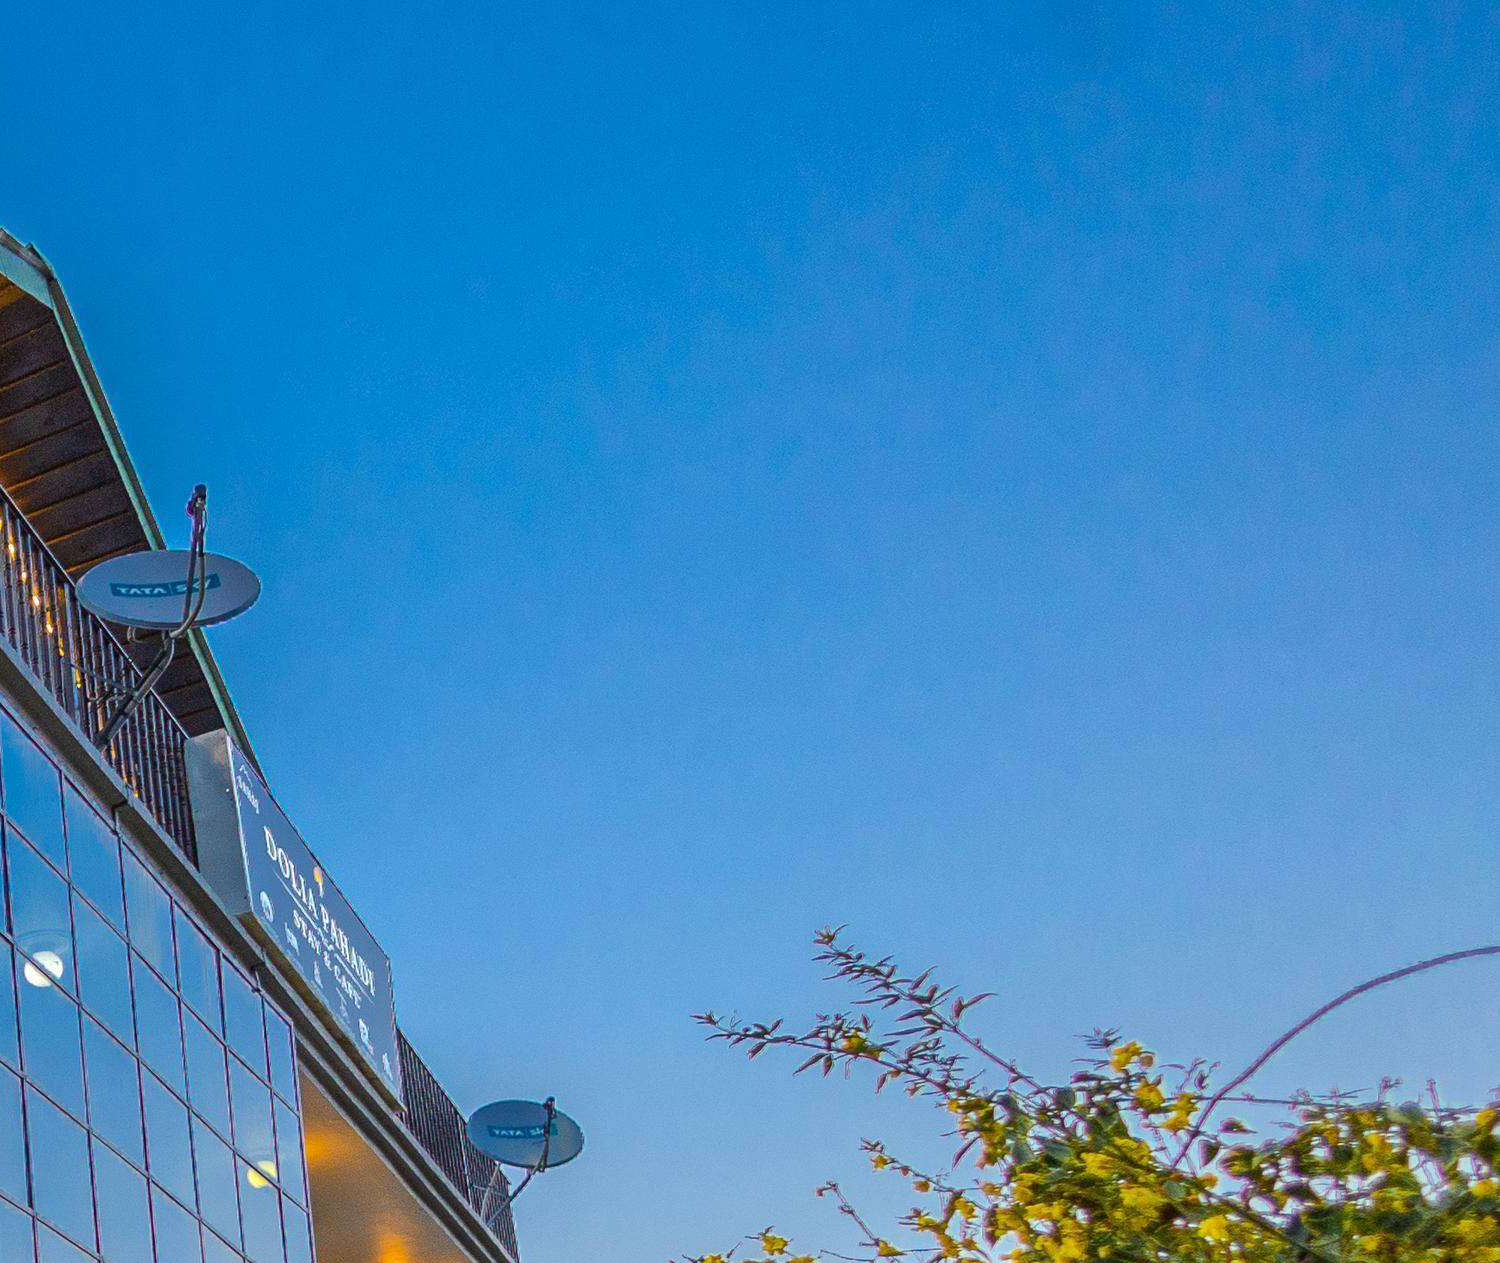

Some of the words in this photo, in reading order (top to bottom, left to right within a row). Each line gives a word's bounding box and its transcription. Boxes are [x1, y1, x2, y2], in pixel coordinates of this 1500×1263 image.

[116, 586, 167, 596] TATA
[264, 825, 318, 920] DOLIA
[319, 903, 375, 997] PAHADI
[293, 909, 320, 955] STAY
[492, 1128, 524, 1137] TATA
